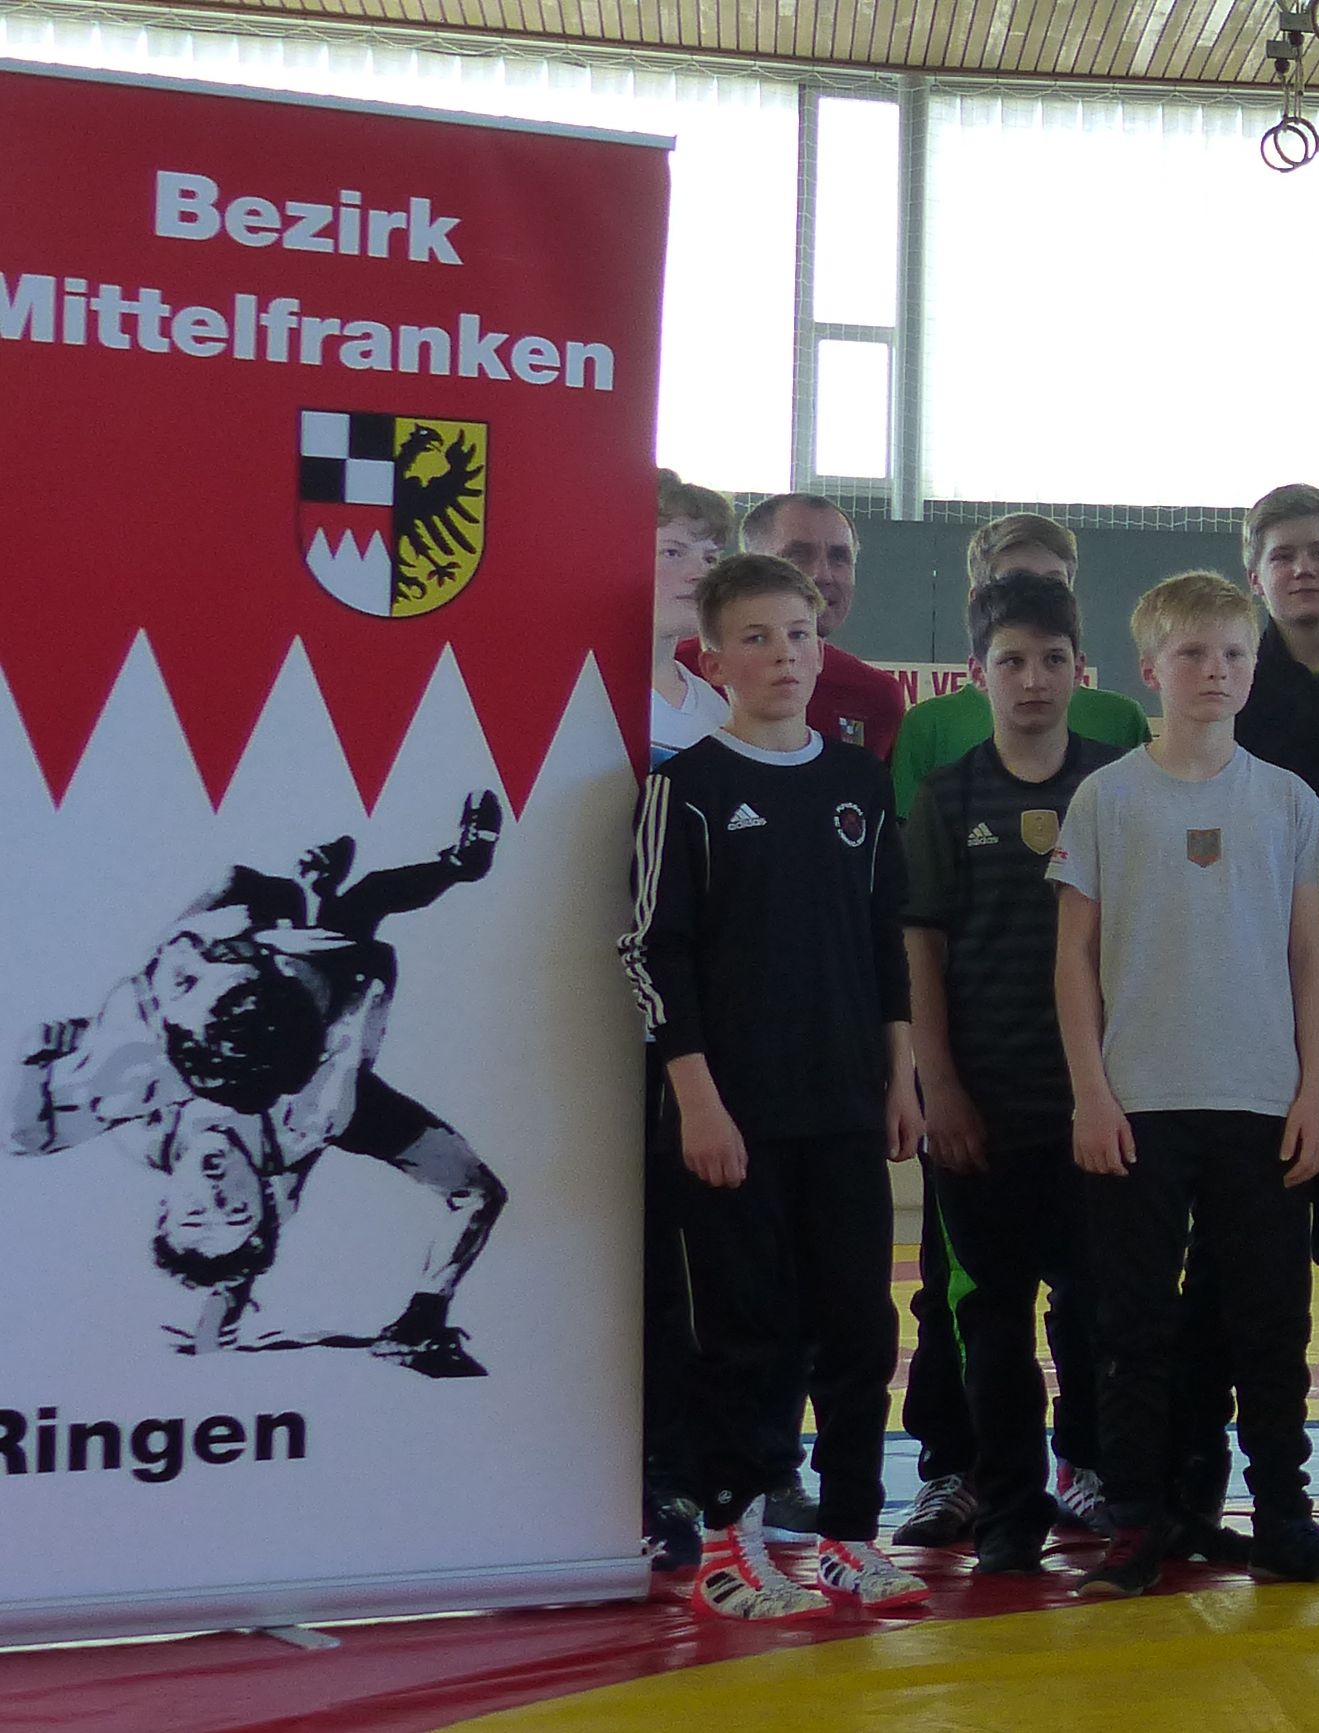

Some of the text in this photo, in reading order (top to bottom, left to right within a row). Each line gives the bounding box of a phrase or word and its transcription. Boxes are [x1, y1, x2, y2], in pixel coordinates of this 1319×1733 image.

[154, 169, 463, 267] Bezirk
[0, 272, 615, 391] Mittelfranken
[727, 816, 768, 831] adidas
[0, 1408, 308, 1484] Ringen
